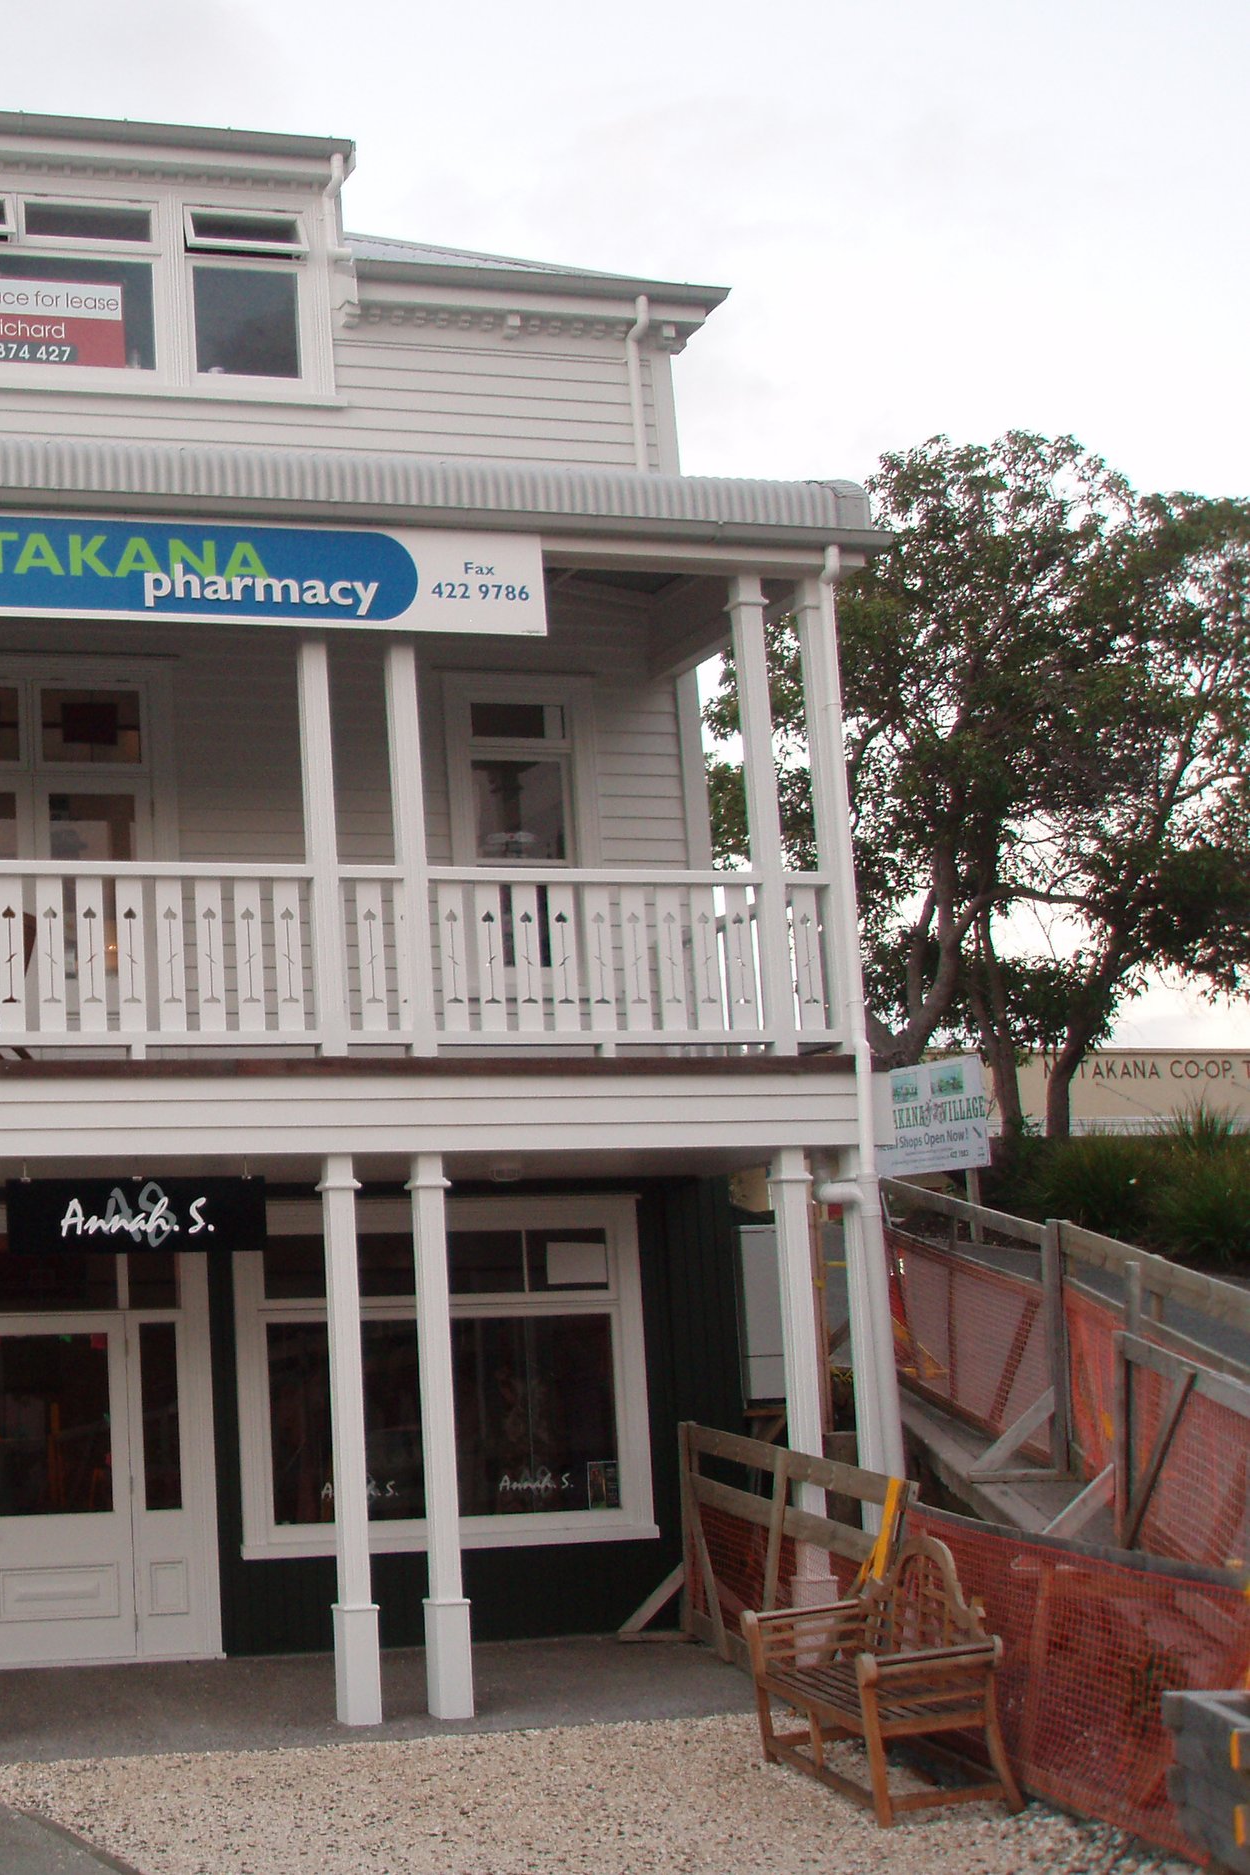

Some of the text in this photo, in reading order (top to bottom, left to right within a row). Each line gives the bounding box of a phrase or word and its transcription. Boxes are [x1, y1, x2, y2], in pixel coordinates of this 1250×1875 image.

[34, 290, 60, 307] for
[65, 292, 120, 311] lease
[36, 345, 71, 362] 427
[463, 561, 495, 577] Fax
[143, 563, 380, 617] pharmacy
[431, 582, 530, 602] 422 9786
[1043, 1059, 1161, 1080] TAKANA
[899, 1135, 923, 1151] Shops
[924, 1131, 946, 1148] Open
